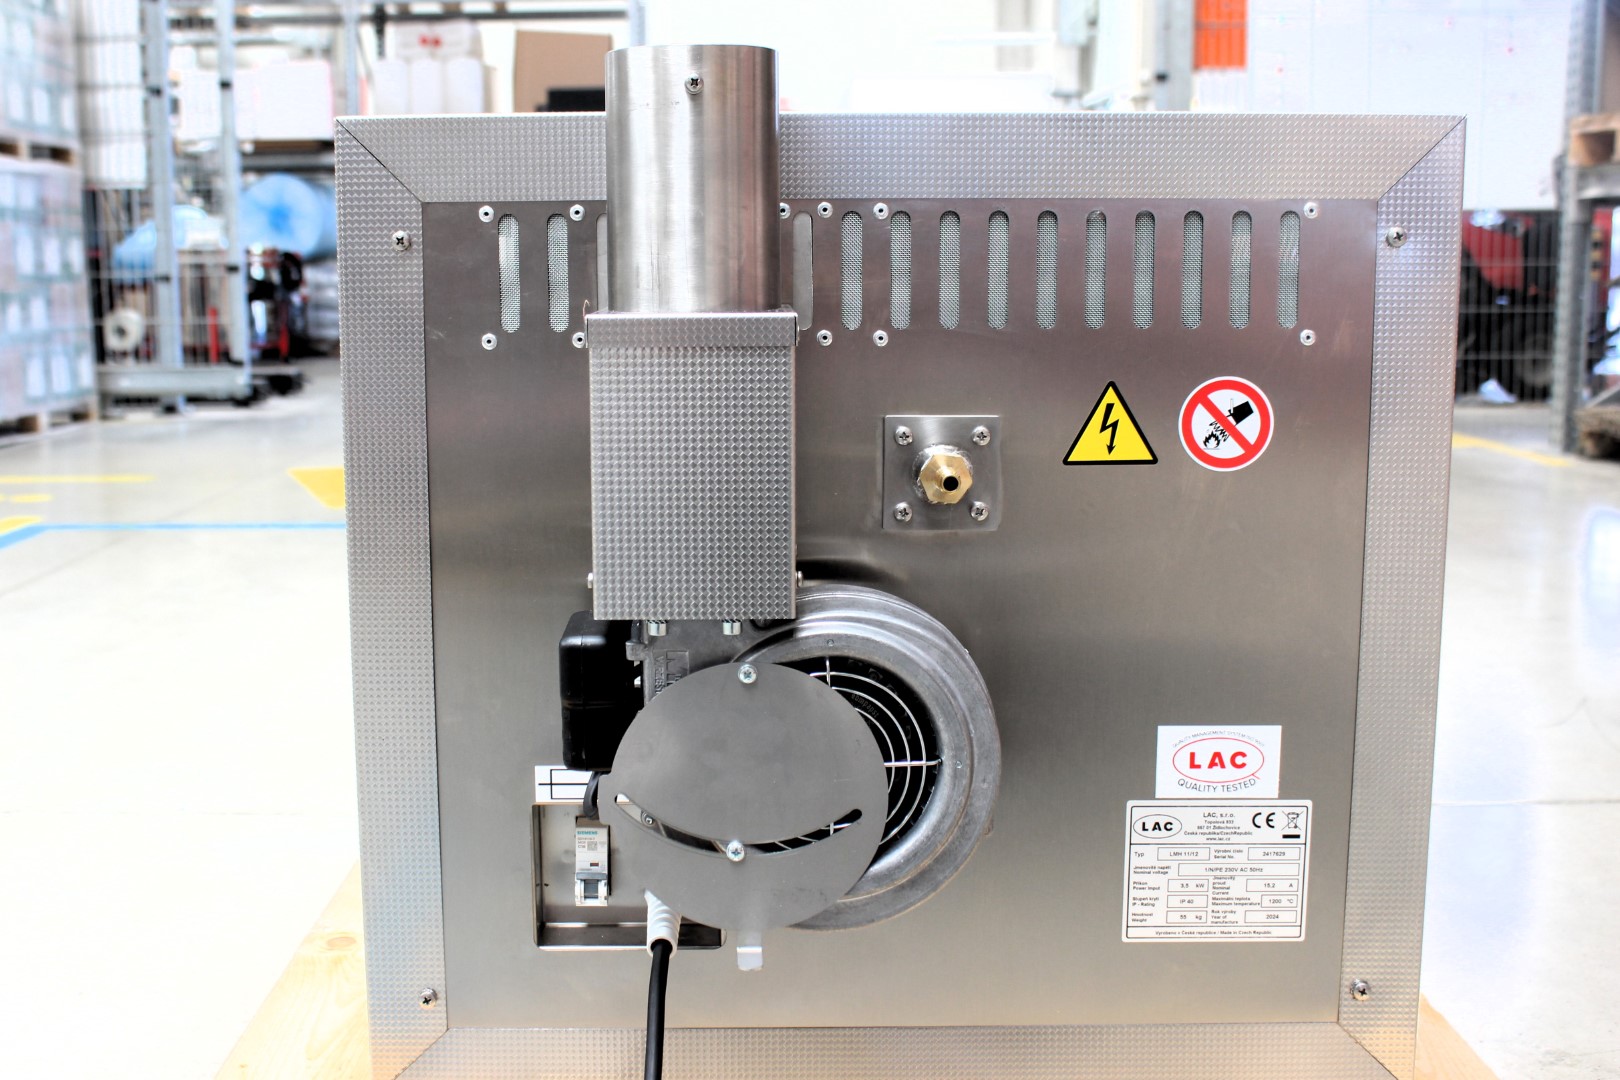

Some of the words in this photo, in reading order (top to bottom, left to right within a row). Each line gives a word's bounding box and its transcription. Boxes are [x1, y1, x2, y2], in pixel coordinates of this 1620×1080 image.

[1189, 751, 1248, 769] LAC
[1177, 778, 1218, 792] QUALITY
[1221, 778, 1256, 792] TESTED
[1142, 822, 1173, 831] LAC
